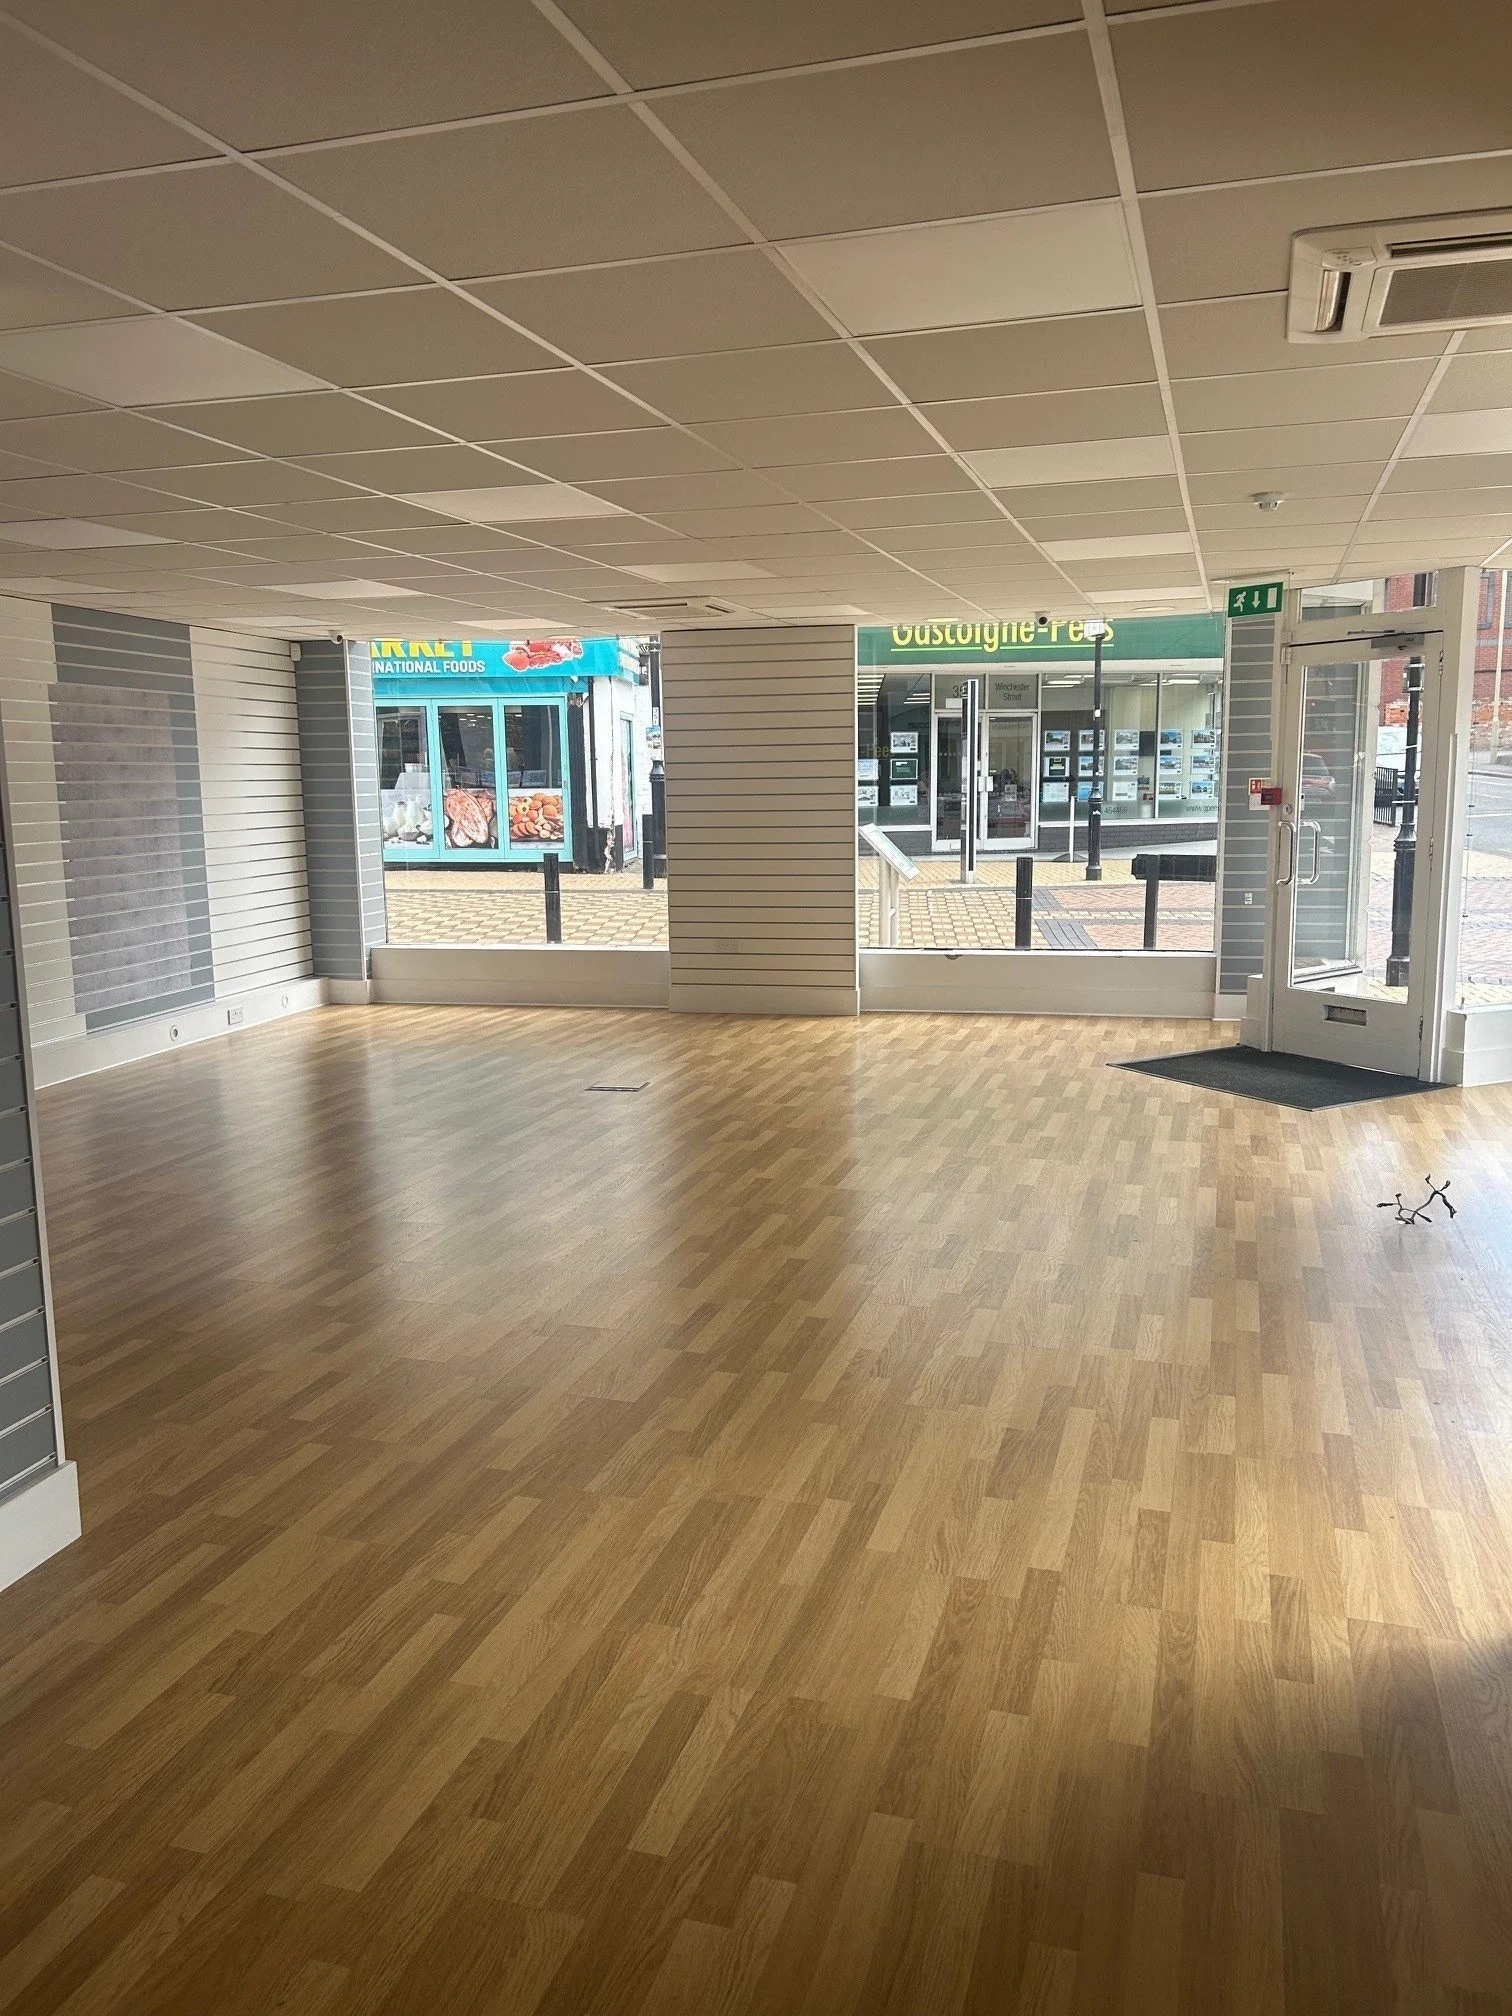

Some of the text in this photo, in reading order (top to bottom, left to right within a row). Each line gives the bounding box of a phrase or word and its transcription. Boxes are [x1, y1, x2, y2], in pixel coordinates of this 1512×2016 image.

[443, 660, 486, 673] FOODS
[995, 682, 1030, 691] Winchester
[1003, 692, 1022, 700] Street
